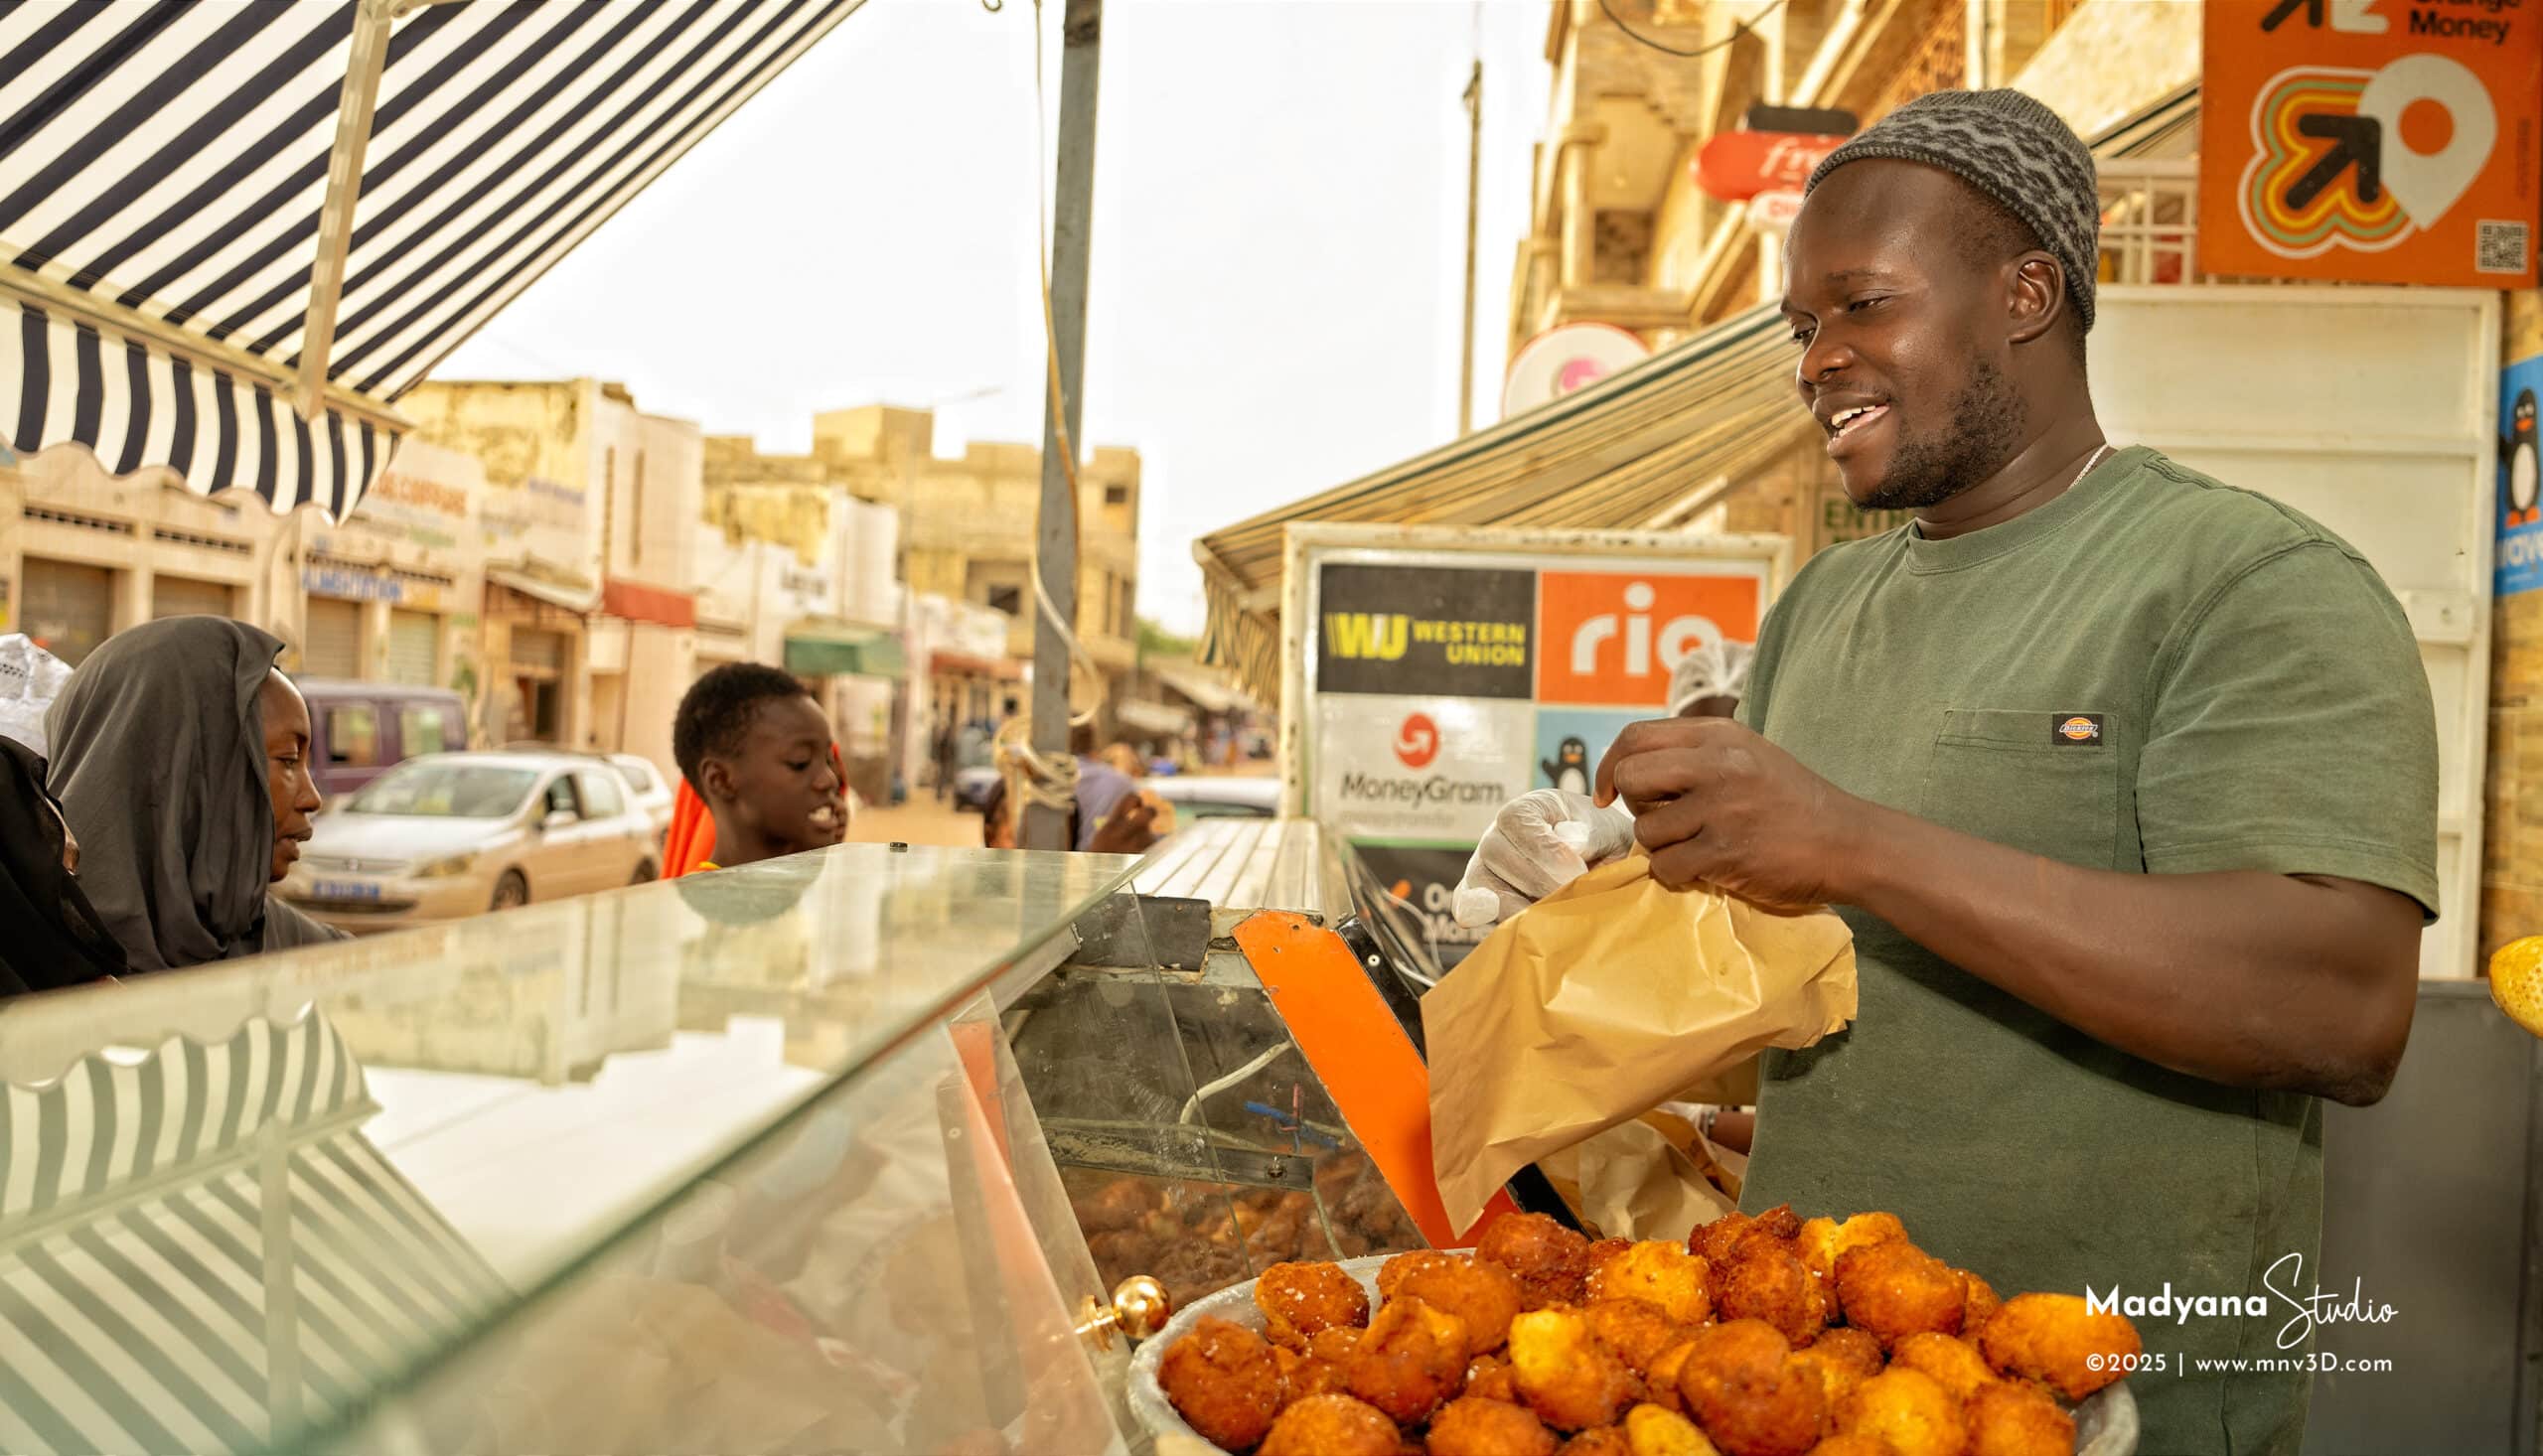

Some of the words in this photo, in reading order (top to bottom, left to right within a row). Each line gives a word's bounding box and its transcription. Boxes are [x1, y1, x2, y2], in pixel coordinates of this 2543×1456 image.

[2409, 9, 2510, 45] Money
[1325, 612, 1409, 660] WU
[1414, 620, 1526, 644] WESTERN
[1445, 644, 1526, 666] UNION
[1340, 773, 1506, 809] MoneyGram
